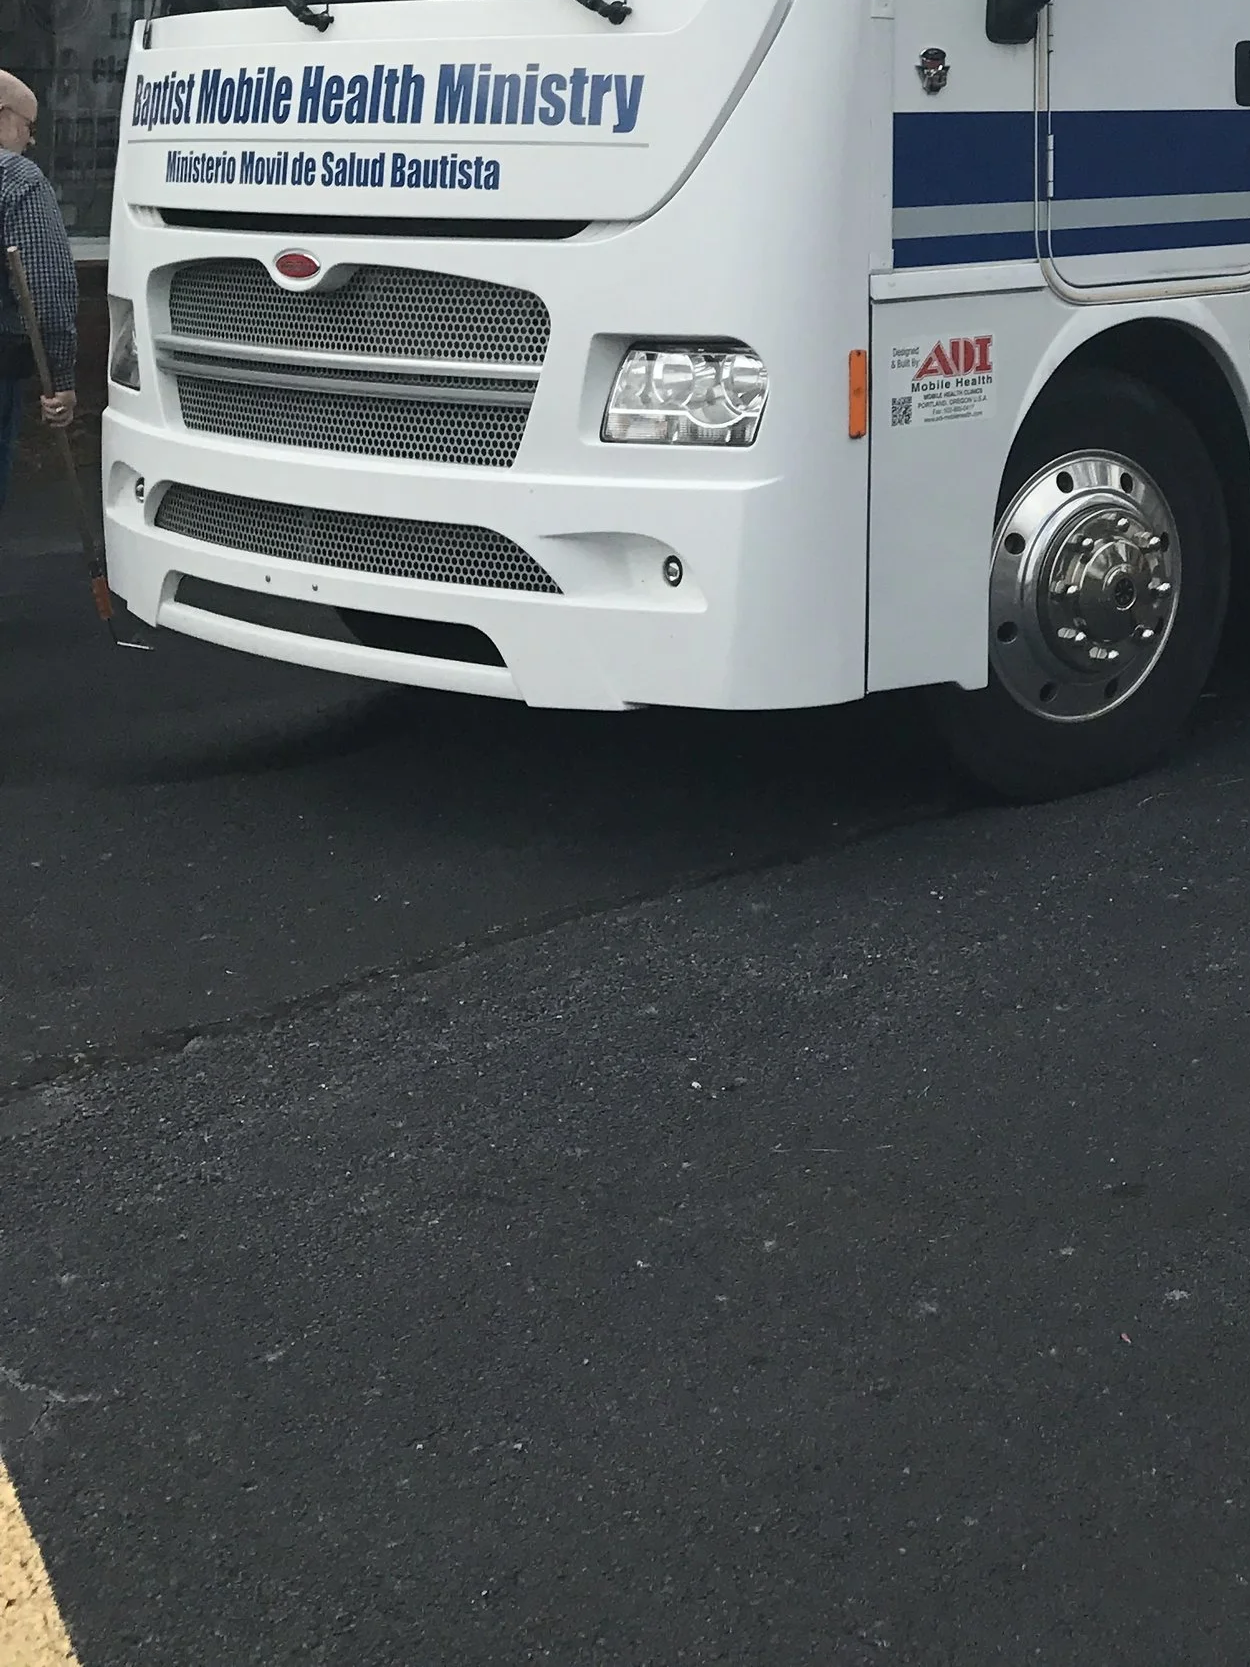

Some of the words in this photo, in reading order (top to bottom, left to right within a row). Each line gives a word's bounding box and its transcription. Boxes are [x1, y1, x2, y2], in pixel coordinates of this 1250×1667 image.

[132, 71, 195, 131] Baptist
[196, 66, 293, 126] Mobile
[298, 64, 425, 125] Health
[434, 63, 646, 133] Ministry
[165, 150, 235, 186] Ministerio
[239, 150, 288, 186] Movil
[290, 151, 316, 187] de
[320, 151, 385, 189] Salud
[390, 152, 500, 191] Bautista
[911, 334, 993, 381] ADI
[911, 381, 951, 393] Mobile
[955, 375, 993, 387] Health
